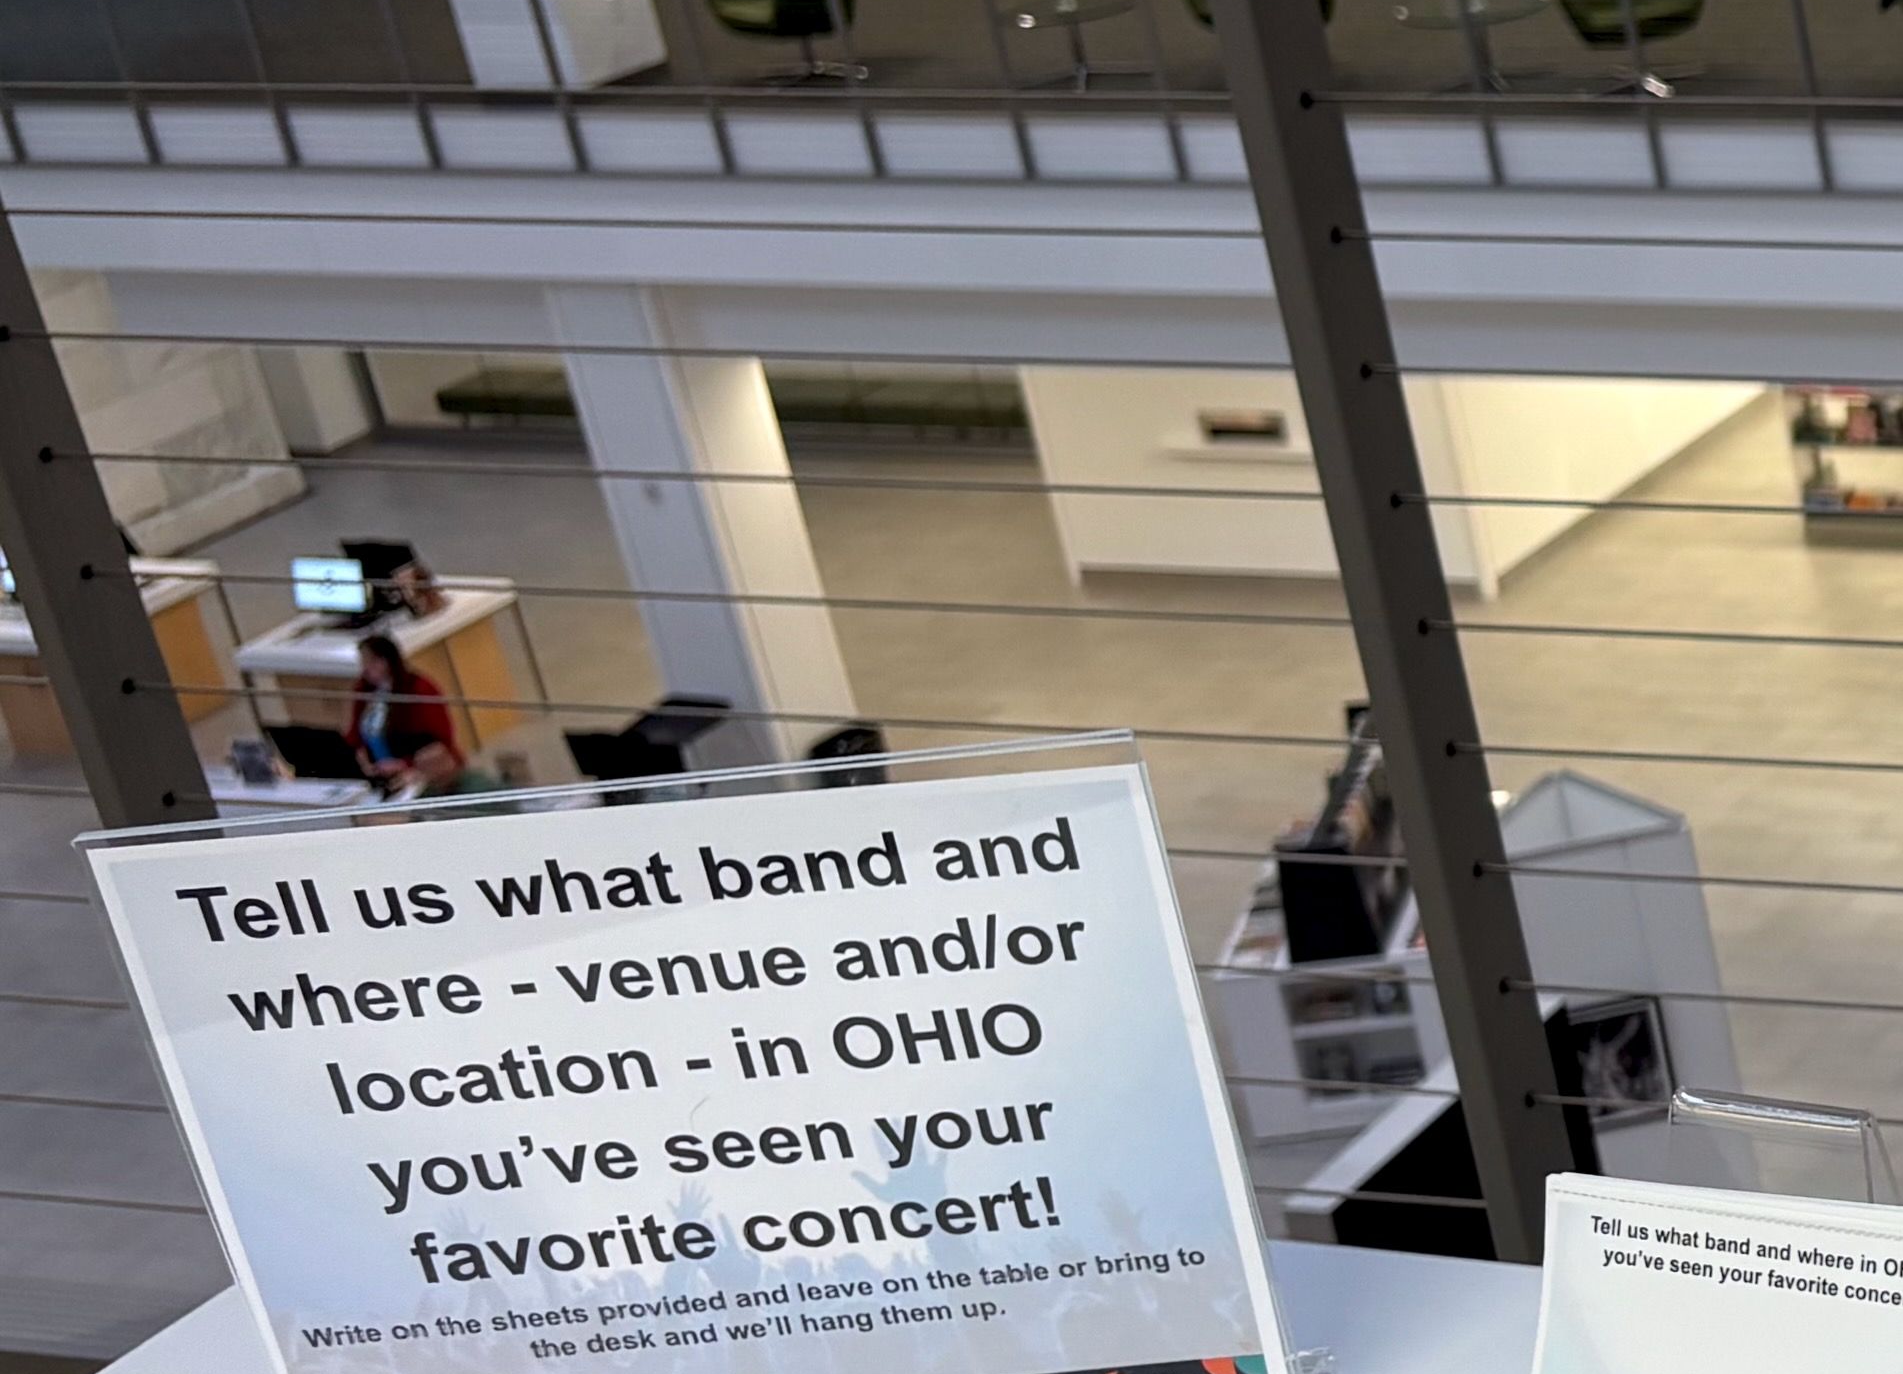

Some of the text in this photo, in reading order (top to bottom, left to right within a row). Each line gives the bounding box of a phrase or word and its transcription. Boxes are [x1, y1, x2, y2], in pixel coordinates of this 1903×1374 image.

[175, 817, 1080, 942] Tell us what band and
[227, 914, 1084, 1031] where venue and/or
[326, 1003, 1042, 1114] location in OHIO
[367, 1102, 1053, 1215] you've seen your
[410, 1176, 1060, 1283] favorite concert!
[1603, 1249, 1664, 1270] you've
[1670, 1259, 1713, 1278] seen
[1719, 1266, 1763, 1285] your
[1768, 1269, 1838, 1296] favorite
[530, 1302, 1006, 1358] the desk and we'll hang them up.
